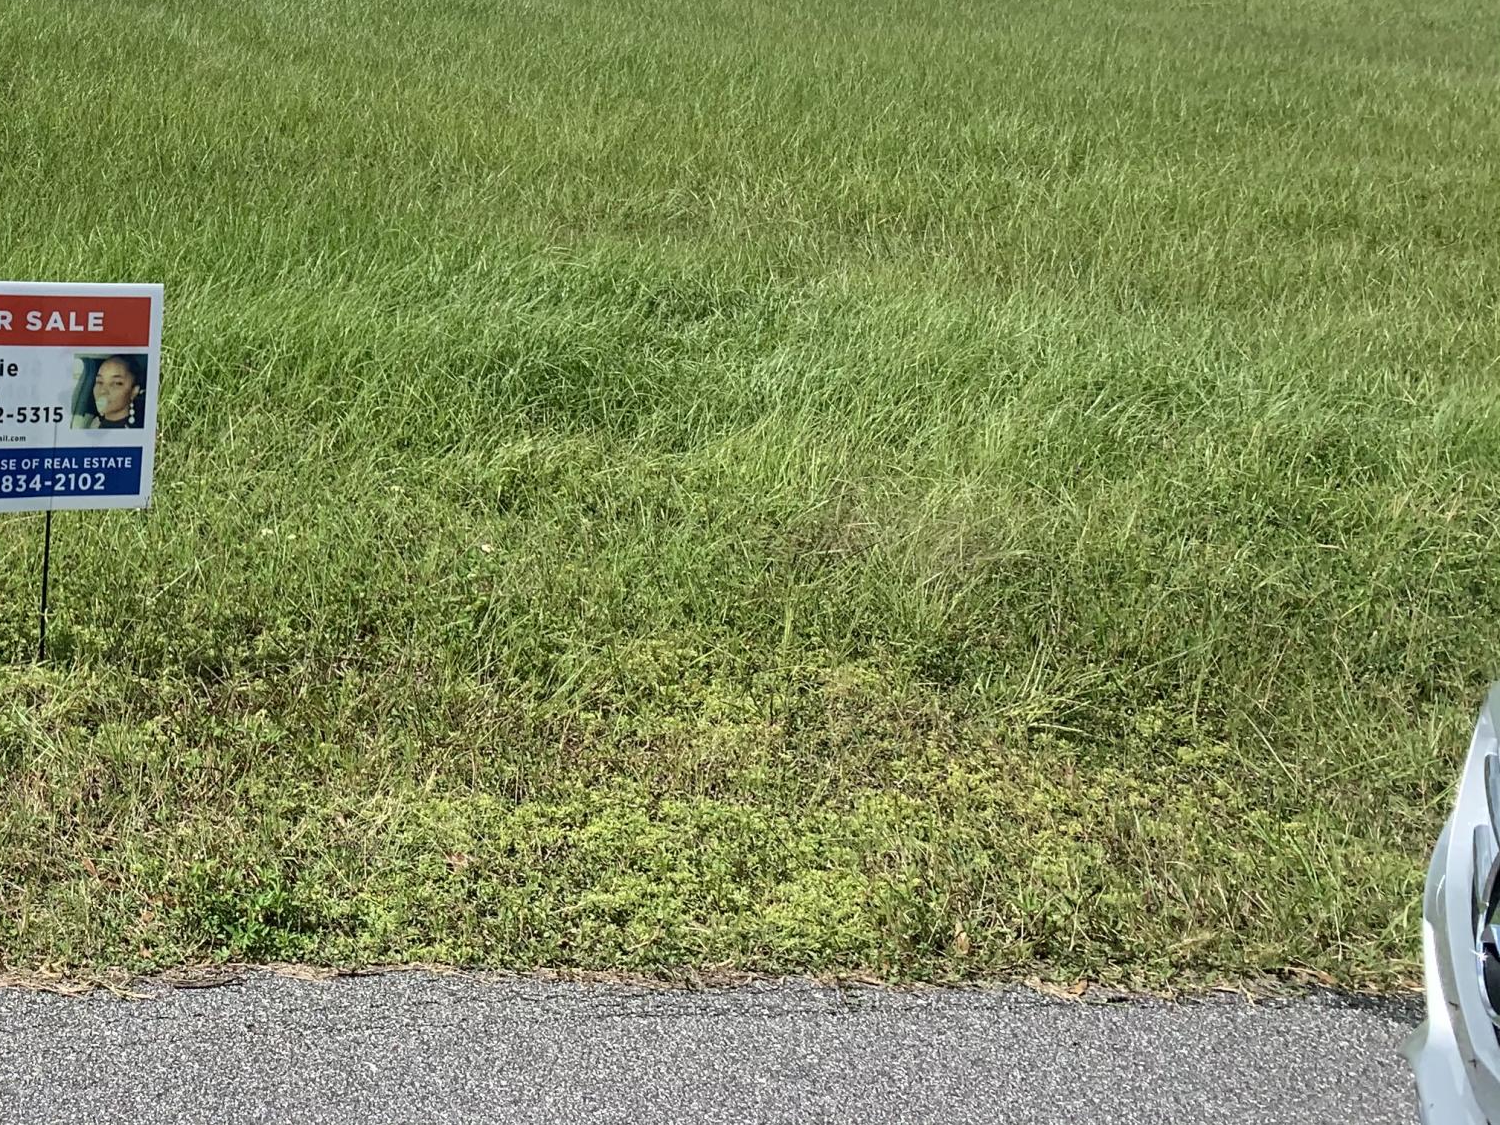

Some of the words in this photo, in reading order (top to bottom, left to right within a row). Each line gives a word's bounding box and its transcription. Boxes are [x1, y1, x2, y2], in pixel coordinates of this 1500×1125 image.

[25, 310, 105, 332] SALE
[21, 459, 40, 470] OF
[44, 458, 78, 469] REAL
[83, 457, 132, 468] ESTATE
